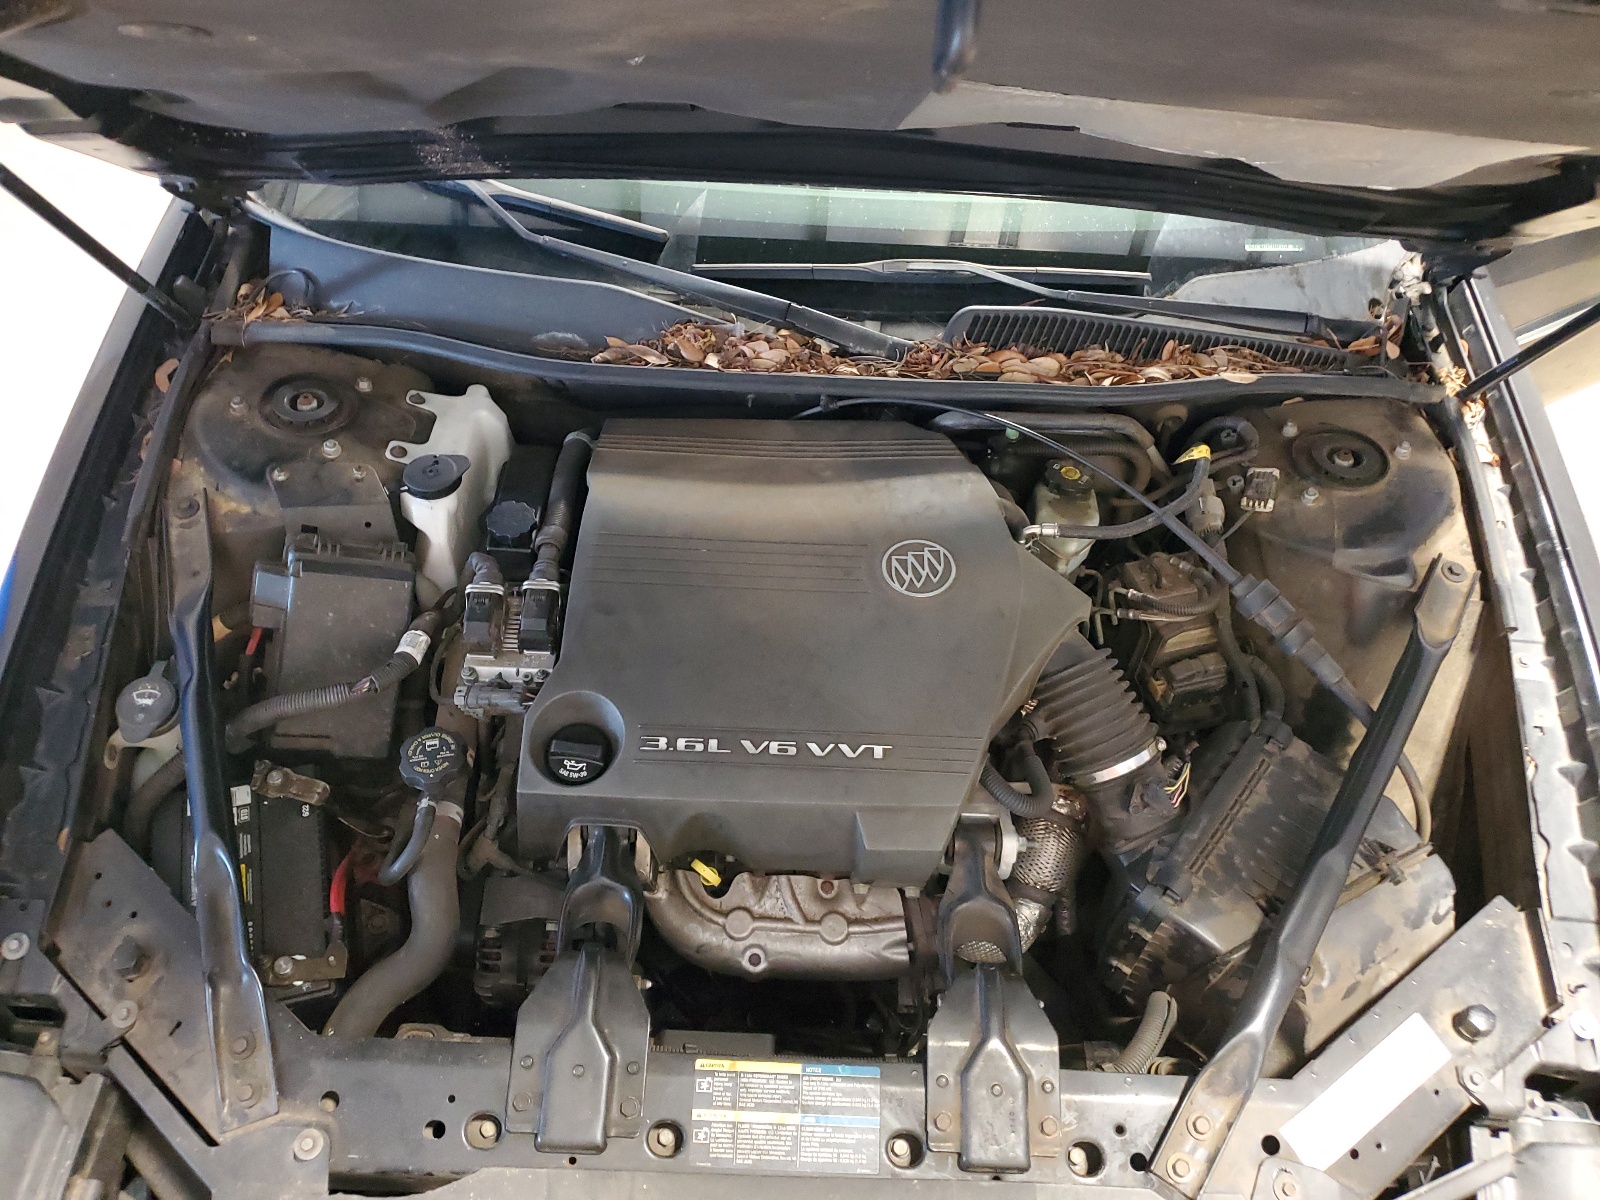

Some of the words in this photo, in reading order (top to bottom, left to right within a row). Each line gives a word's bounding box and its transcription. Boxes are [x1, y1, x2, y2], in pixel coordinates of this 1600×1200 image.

[639, 736, 732, 753] 3.6L
[740, 739, 797, 756] V6
[806, 742, 893, 759] VVT
[559, 768, 569, 777] SAE
